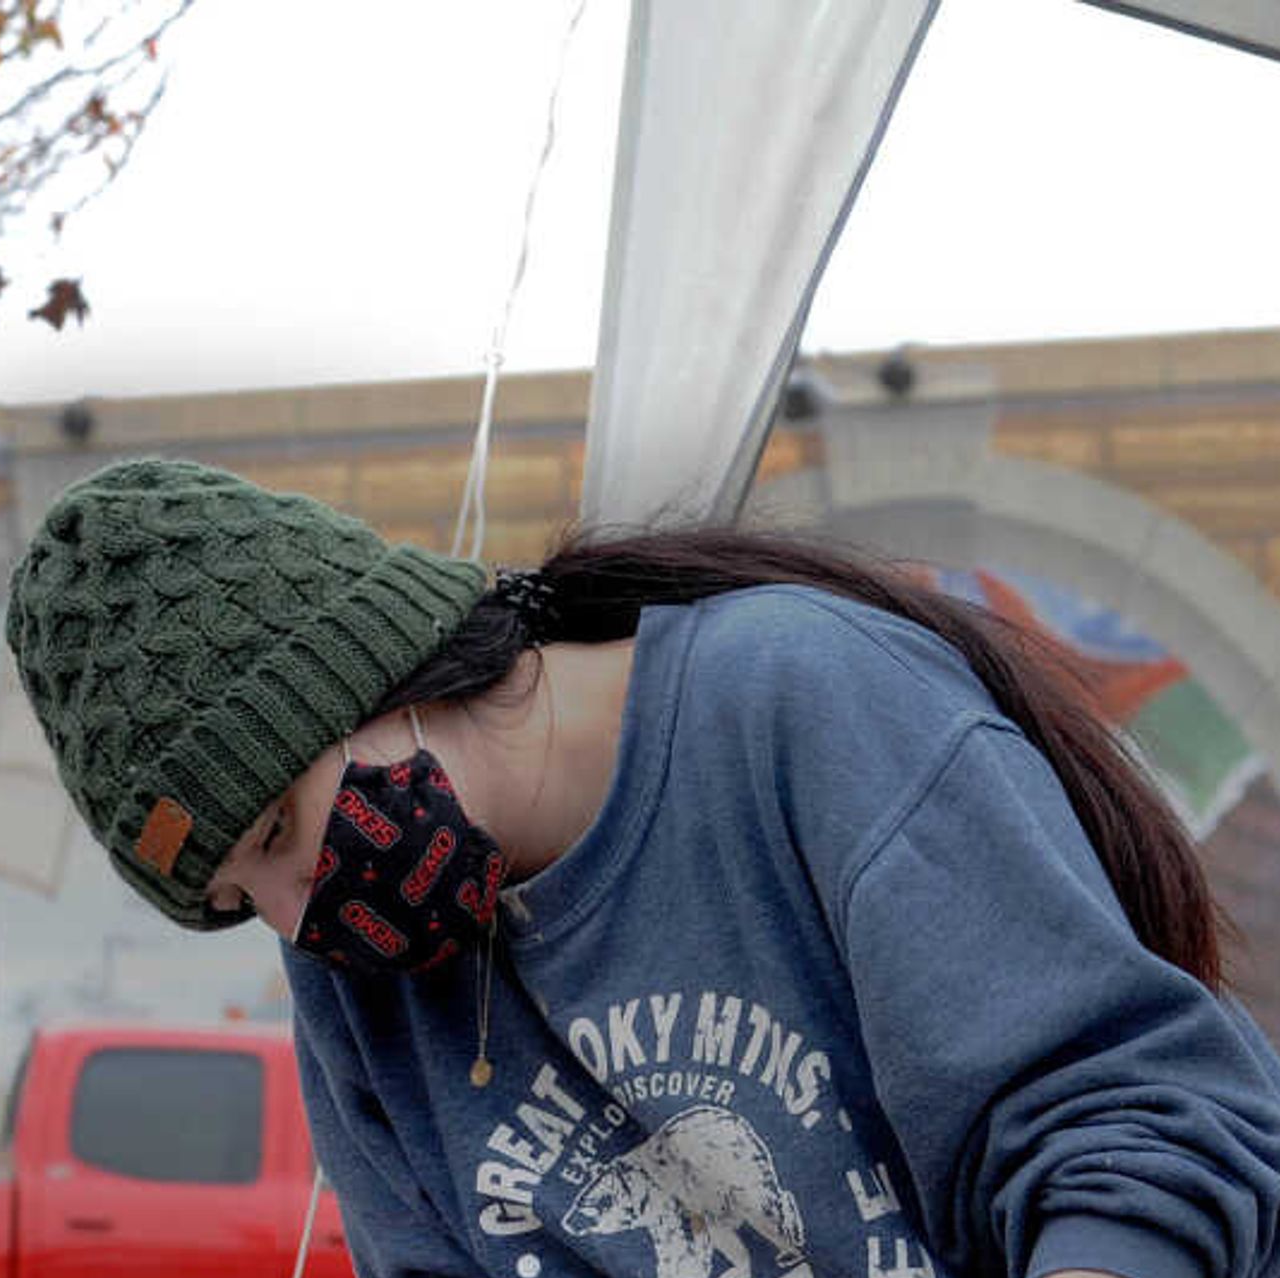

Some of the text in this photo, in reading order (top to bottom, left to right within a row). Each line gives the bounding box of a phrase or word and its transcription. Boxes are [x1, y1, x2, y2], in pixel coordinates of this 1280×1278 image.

[336, 788, 400, 848] SEMO
[402, 829, 455, 904] SEMO
[341, 902, 407, 957] SEMO
[476, 1063, 586, 1236] GREAT
[568, 993, 683, 1084] OKY
[561, 1102, 627, 1187] EXPLO
